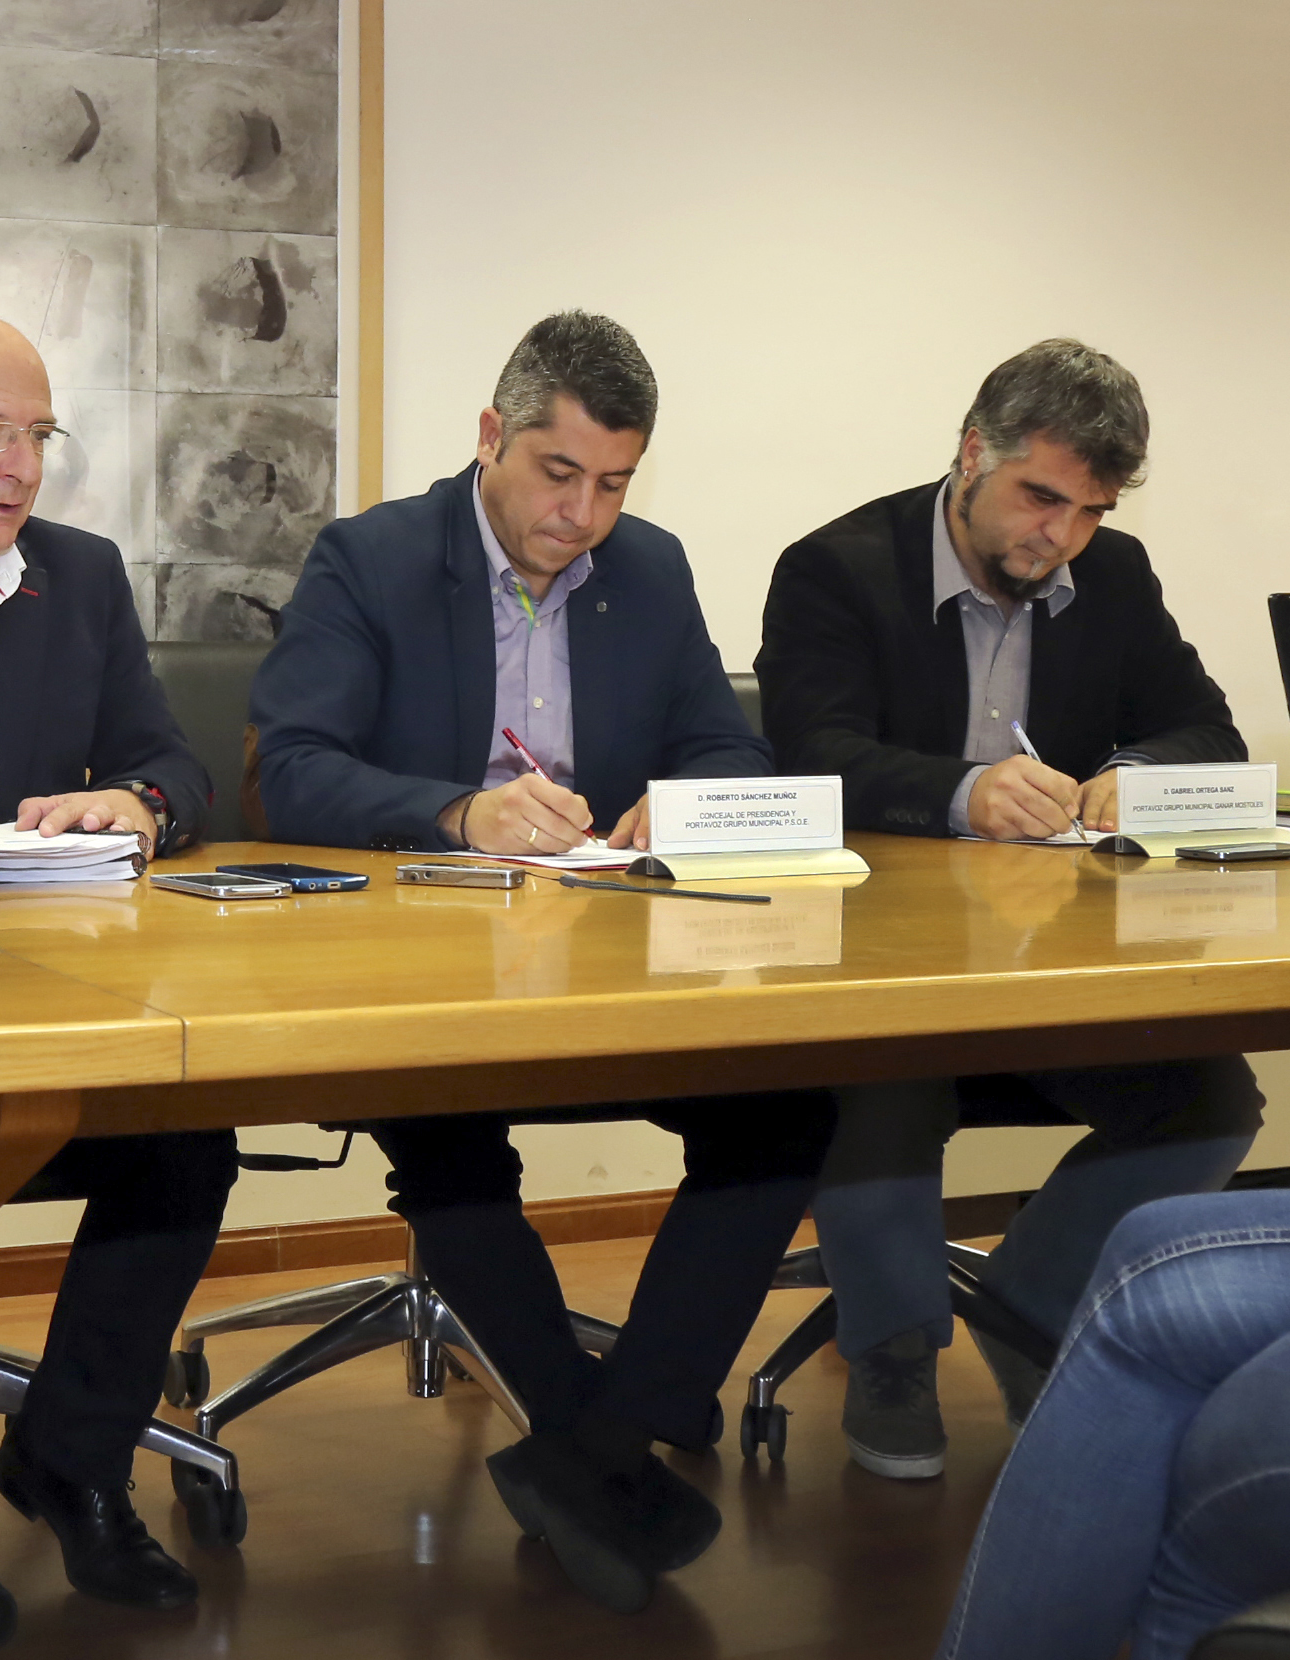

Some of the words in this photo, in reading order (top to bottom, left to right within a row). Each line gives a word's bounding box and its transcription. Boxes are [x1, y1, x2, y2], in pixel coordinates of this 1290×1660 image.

[741, 792, 772, 800] SÁNCHEZ
[773, 791, 797, 800] MUÑOZ
[699, 812, 735, 820] CONCEJAL
[746, 810, 790, 818] PRESIDENCIA
[685, 821, 722, 829] PORTAVOZ
[723, 820, 747, 828] GRUPO
[749, 819, 783, 827] MUNICIPAL
